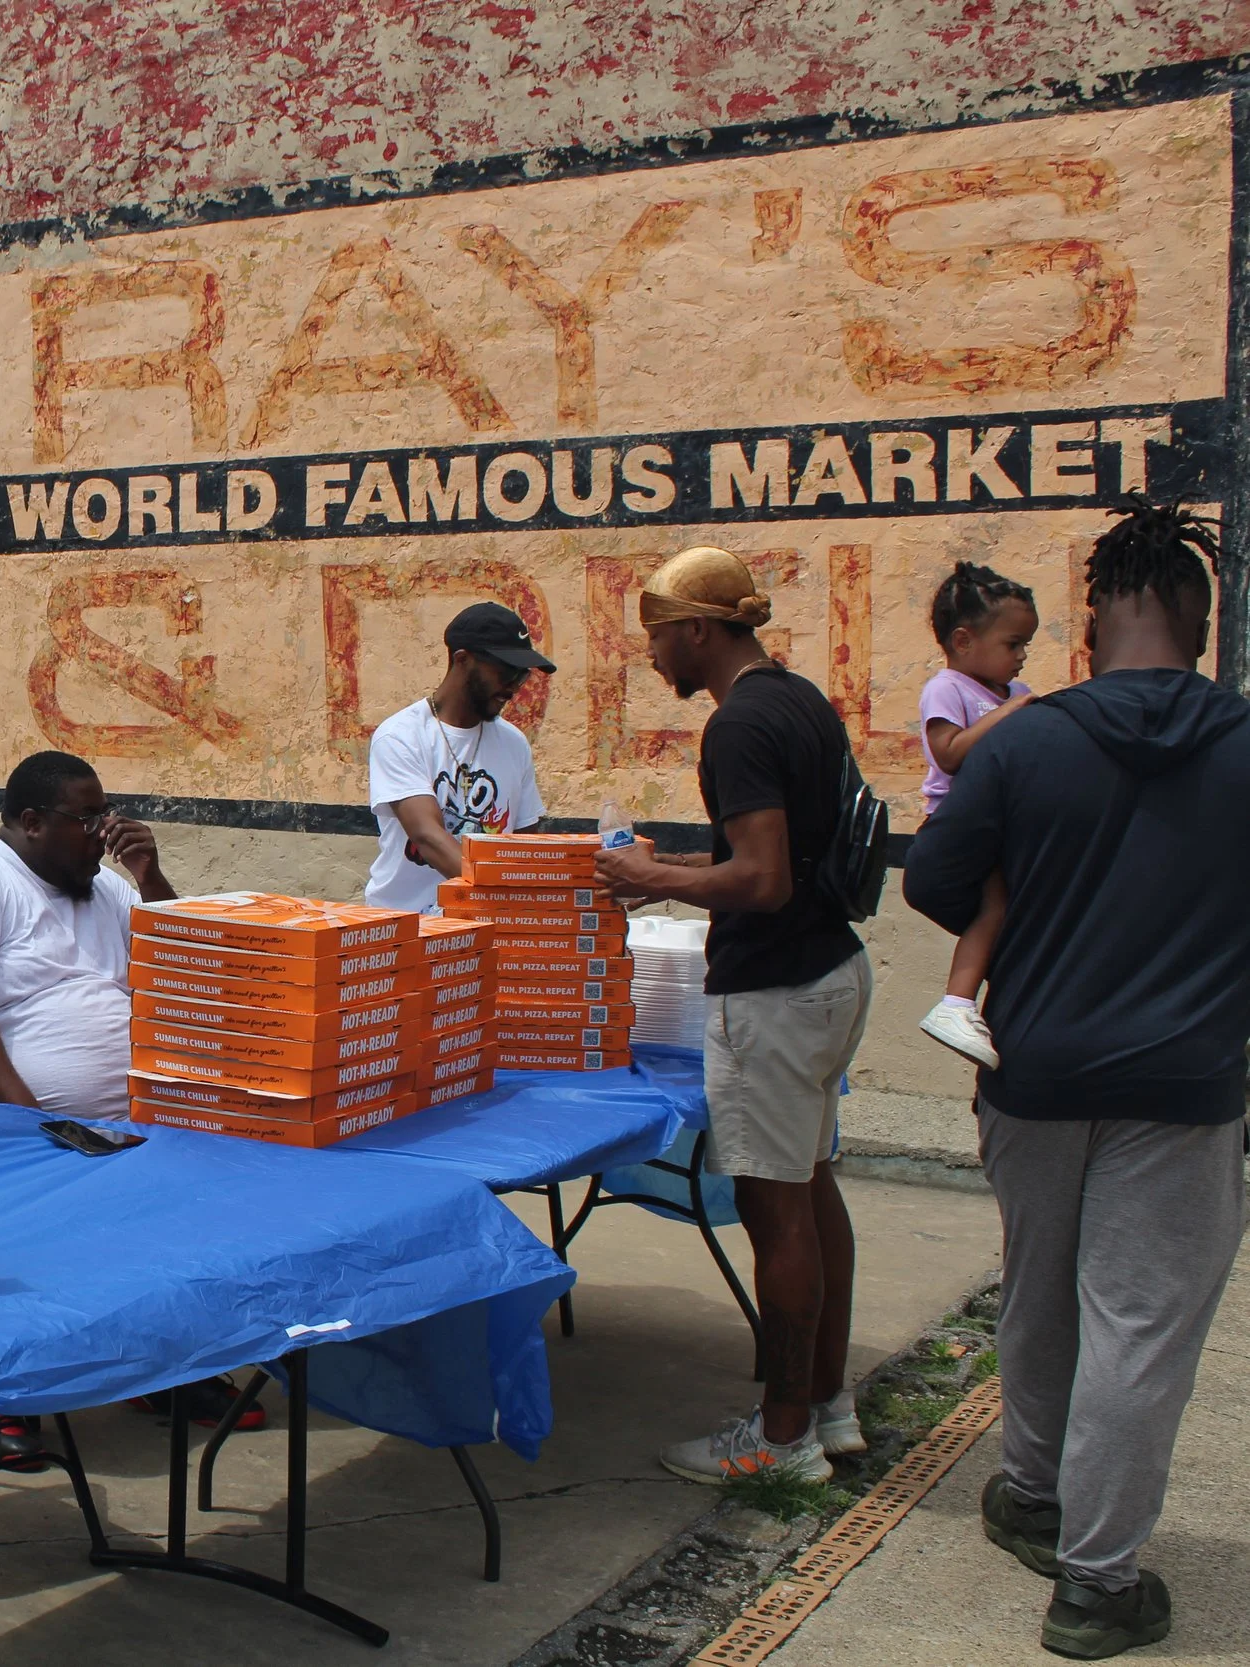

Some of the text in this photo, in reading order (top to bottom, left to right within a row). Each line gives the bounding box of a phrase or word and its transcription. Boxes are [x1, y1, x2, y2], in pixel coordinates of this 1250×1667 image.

[31, 153, 1138, 465] RAY'S
[7, 413, 1172, 541] WORLD FAMOUS MARKET
[27, 569, 243, 759] &
[496, 850, 531, 858] SUMMER
[533, 851, 566, 859] CHILLIN'
[501, 872, 536, 880] SUMMER
[539, 873, 571, 881] CHILLIN'
[154, 922, 189, 935] SUMMER
[190, 927, 223, 939] CHILLIN'
[542, 918, 573, 926] REPEAT
[154, 951, 188, 964] SUMMER
[190, 956, 223, 968] CHILLIN'
[550, 964, 580, 972] REPEAT
[153, 978, 188, 990] SUMMER
[189, 982, 222, 995] CHILLIN'
[155, 1006, 190, 1019] SUMMER
[191, 1011, 224, 1023] CHILLIN'
[552, 1011, 582, 1019] REPEAT
[154, 1032, 188, 1046] SUMMER
[190, 1038, 222, 1050] CHILLIN'
[155, 1060, 189, 1073] SUMMER
[190, 1065, 222, 1077] CHILLIN'
[151, 1086, 186, 1099] SUMMER
[187, 1091, 220, 1103] CHILLIN'
[154, 1114, 189, 1126] SUMMER
[190, 1119, 223, 1131] CHILLIN'
